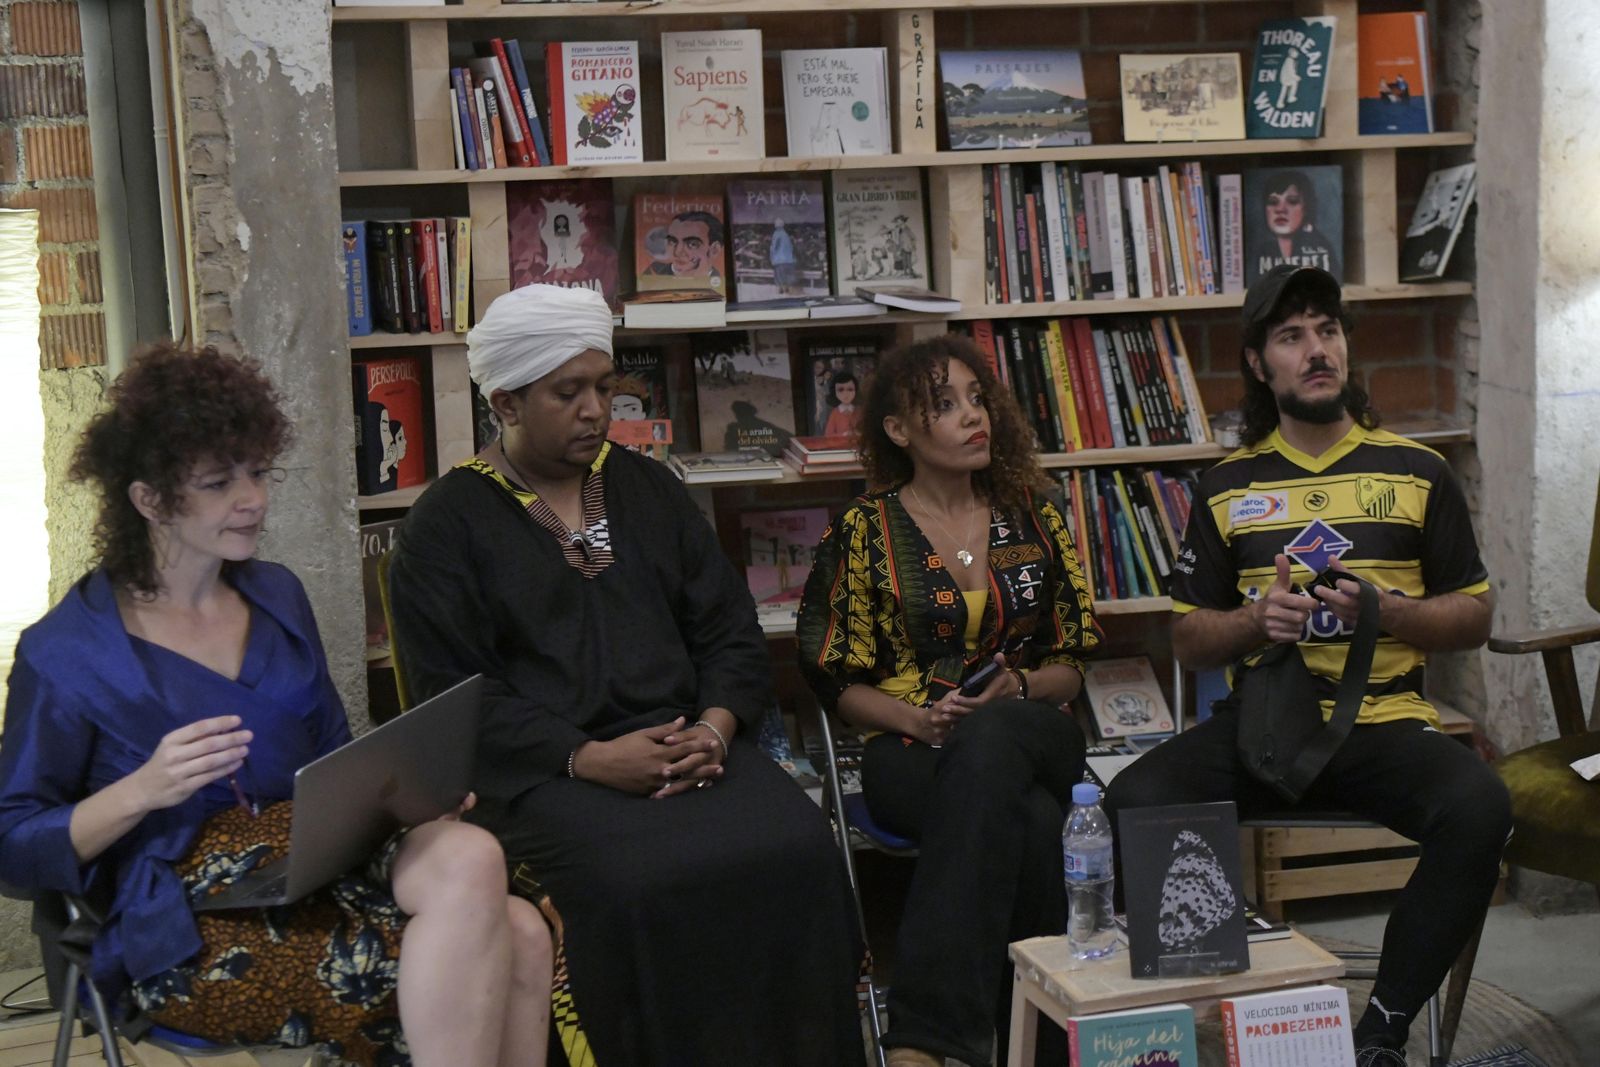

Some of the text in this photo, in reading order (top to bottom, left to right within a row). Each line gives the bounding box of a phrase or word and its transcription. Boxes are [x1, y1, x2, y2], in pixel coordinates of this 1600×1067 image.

[1262, 29, 1322, 77] THOREAU
[571, 57, 633, 68] ROMANCERO
[975, 64, 1051, 74] PAISAJES
[571, 67, 633, 81] GITANO
[674, 65, 748, 91] Sapiens
[1258, 69, 1277, 82] EN
[1254, 91, 1316, 128] WALDEN
[641, 196, 721, 214] Federico
[746, 190, 811, 205] PATRIA
[1244, 1000, 1341, 1019] VELOCIDAD MÍNIMA
[1093, 1031, 1141, 1057] Hija
[1146, 1025, 1184, 1046] del
